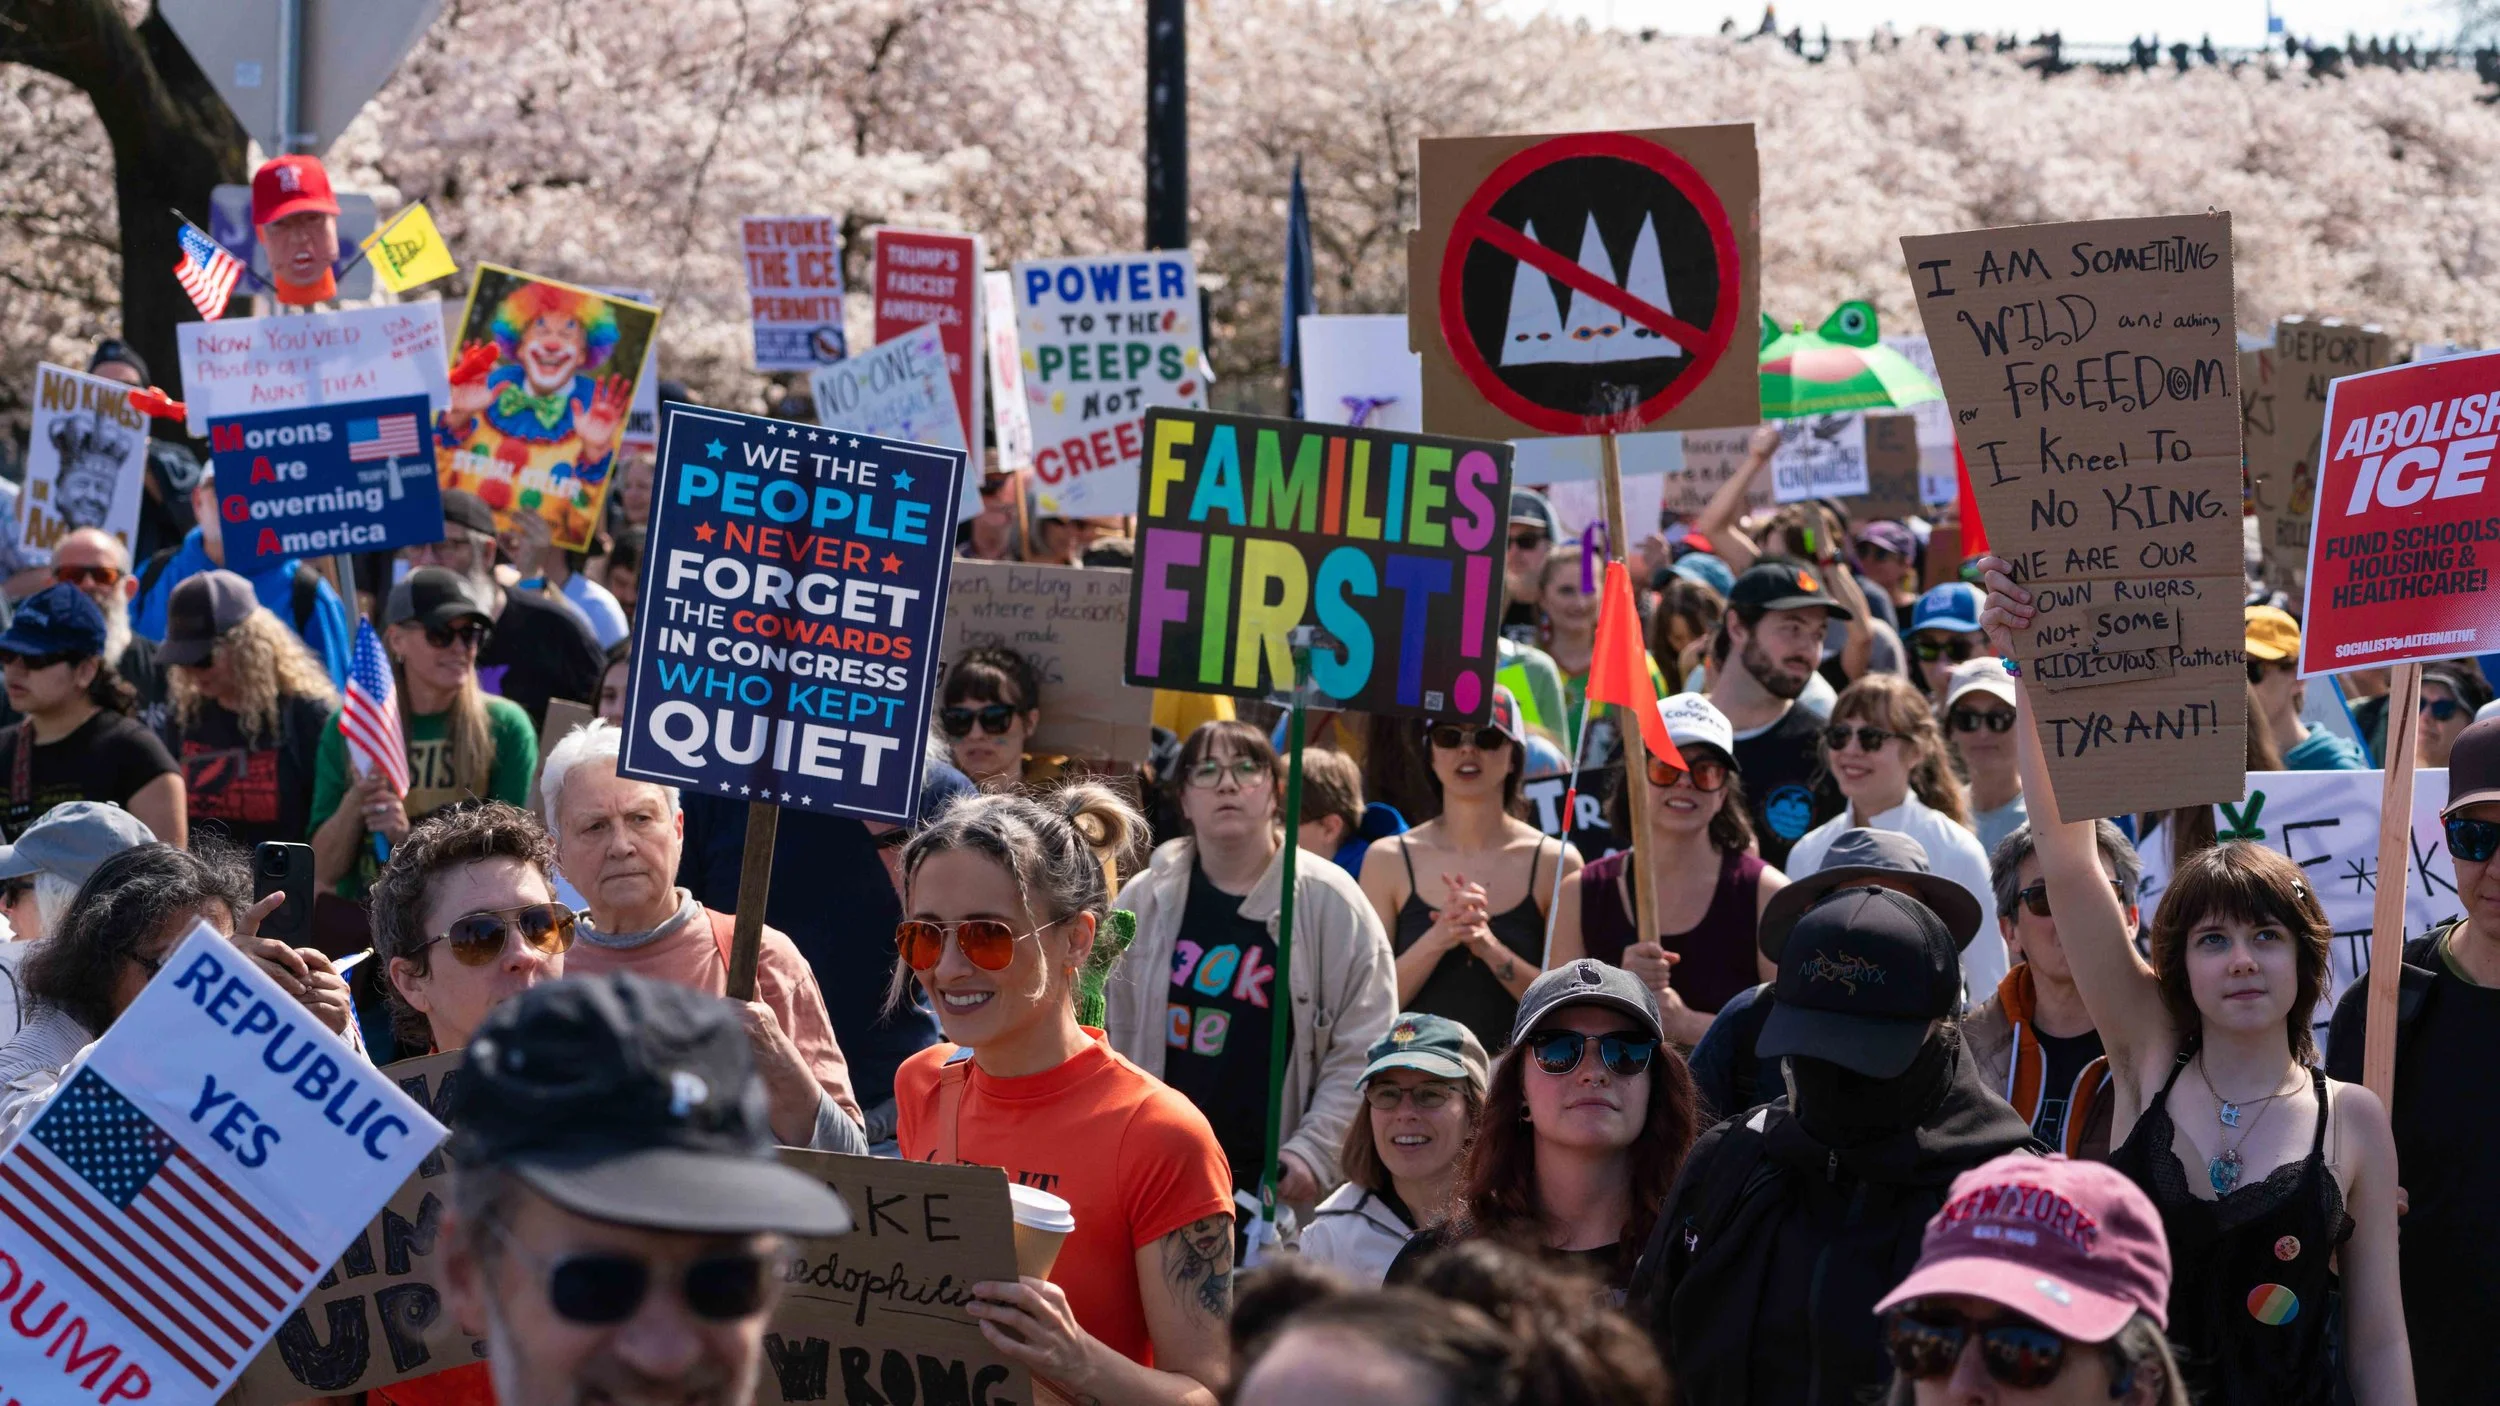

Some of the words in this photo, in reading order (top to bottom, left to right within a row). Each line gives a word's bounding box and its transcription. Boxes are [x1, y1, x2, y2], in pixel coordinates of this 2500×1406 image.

[744, 219, 832, 246] REVOKE
[747, 251, 790, 288] THE
[796, 251, 837, 288] ICE
[886, 244, 960, 272] TRUMP'S
[1918, 259, 1956, 299] I
[1974, 248, 2053, 288] AM
[886, 271, 958, 297] FASCIST
[1025, 261, 1185, 306] POWER
[1059, 312, 1094, 334] TO
[1106, 311, 1160, 334] THE
[1956, 294, 2097, 357] WILD
[2118, 311, 2163, 330] and
[1037, 343, 1184, 382] PEEPS
[42, 371, 77, 411] NO
[818, 368, 860, 419] NO
[1082, 387, 1142, 421] NOT
[211, 422, 333, 452] Morons
[1034, 416, 1145, 486] CREE
[250, 456, 307, 485] Are
[742, 441, 800, 475] WE
[810, 452, 879, 487] THE
[1148, 418, 1499, 552] FAMILIES
[1977, 440, 2022, 489] I
[2345, 434, 2498, 516] ICE
[221, 486, 385, 523] Governing
[677, 463, 931, 545] PEOPLE
[2032, 489, 2078, 531] NO
[256, 522, 387, 556] America
[723, 521, 871, 575] NEVER
[2065, 546, 2118, 573] ARE
[2140, 542, 2197, 568] OUR
[2325, 532, 2389, 560] FUND
[1008, 568, 1072, 600] belong
[2349, 547, 2455, 582] HOUSING
[2459, 545, 2477, 568] &
[666, 549, 920, 628] FORGET
[973, 600, 1035, 620] where
[2037, 581, 2092, 613] OWN
[2332, 569, 2488, 610] HEALTHCARE!
[663, 596, 727, 630] THE
[732, 609, 913, 660] COWARDS
[1135, 528, 1492, 714] FIRST!
[2335, 638, 2393, 659] SOCIALIST
[2404, 628, 2477, 648] ALTERNATIVE
[658, 627, 697, 657] IN
[707, 636, 908, 692] CONGRESS
[657, 658, 772, 706] WHO
[787, 681, 905, 729] KEPT
[649, 699, 900, 787] QUIET
[2046, 700, 2219, 758] TYRANT!
[174, 950, 409, 1163] REPUBLIC
[189, 1073, 281, 1168] YES
[2010, 1180, 2098, 1256] YORK
[763, 1332, 1018, 1406] WRONG
